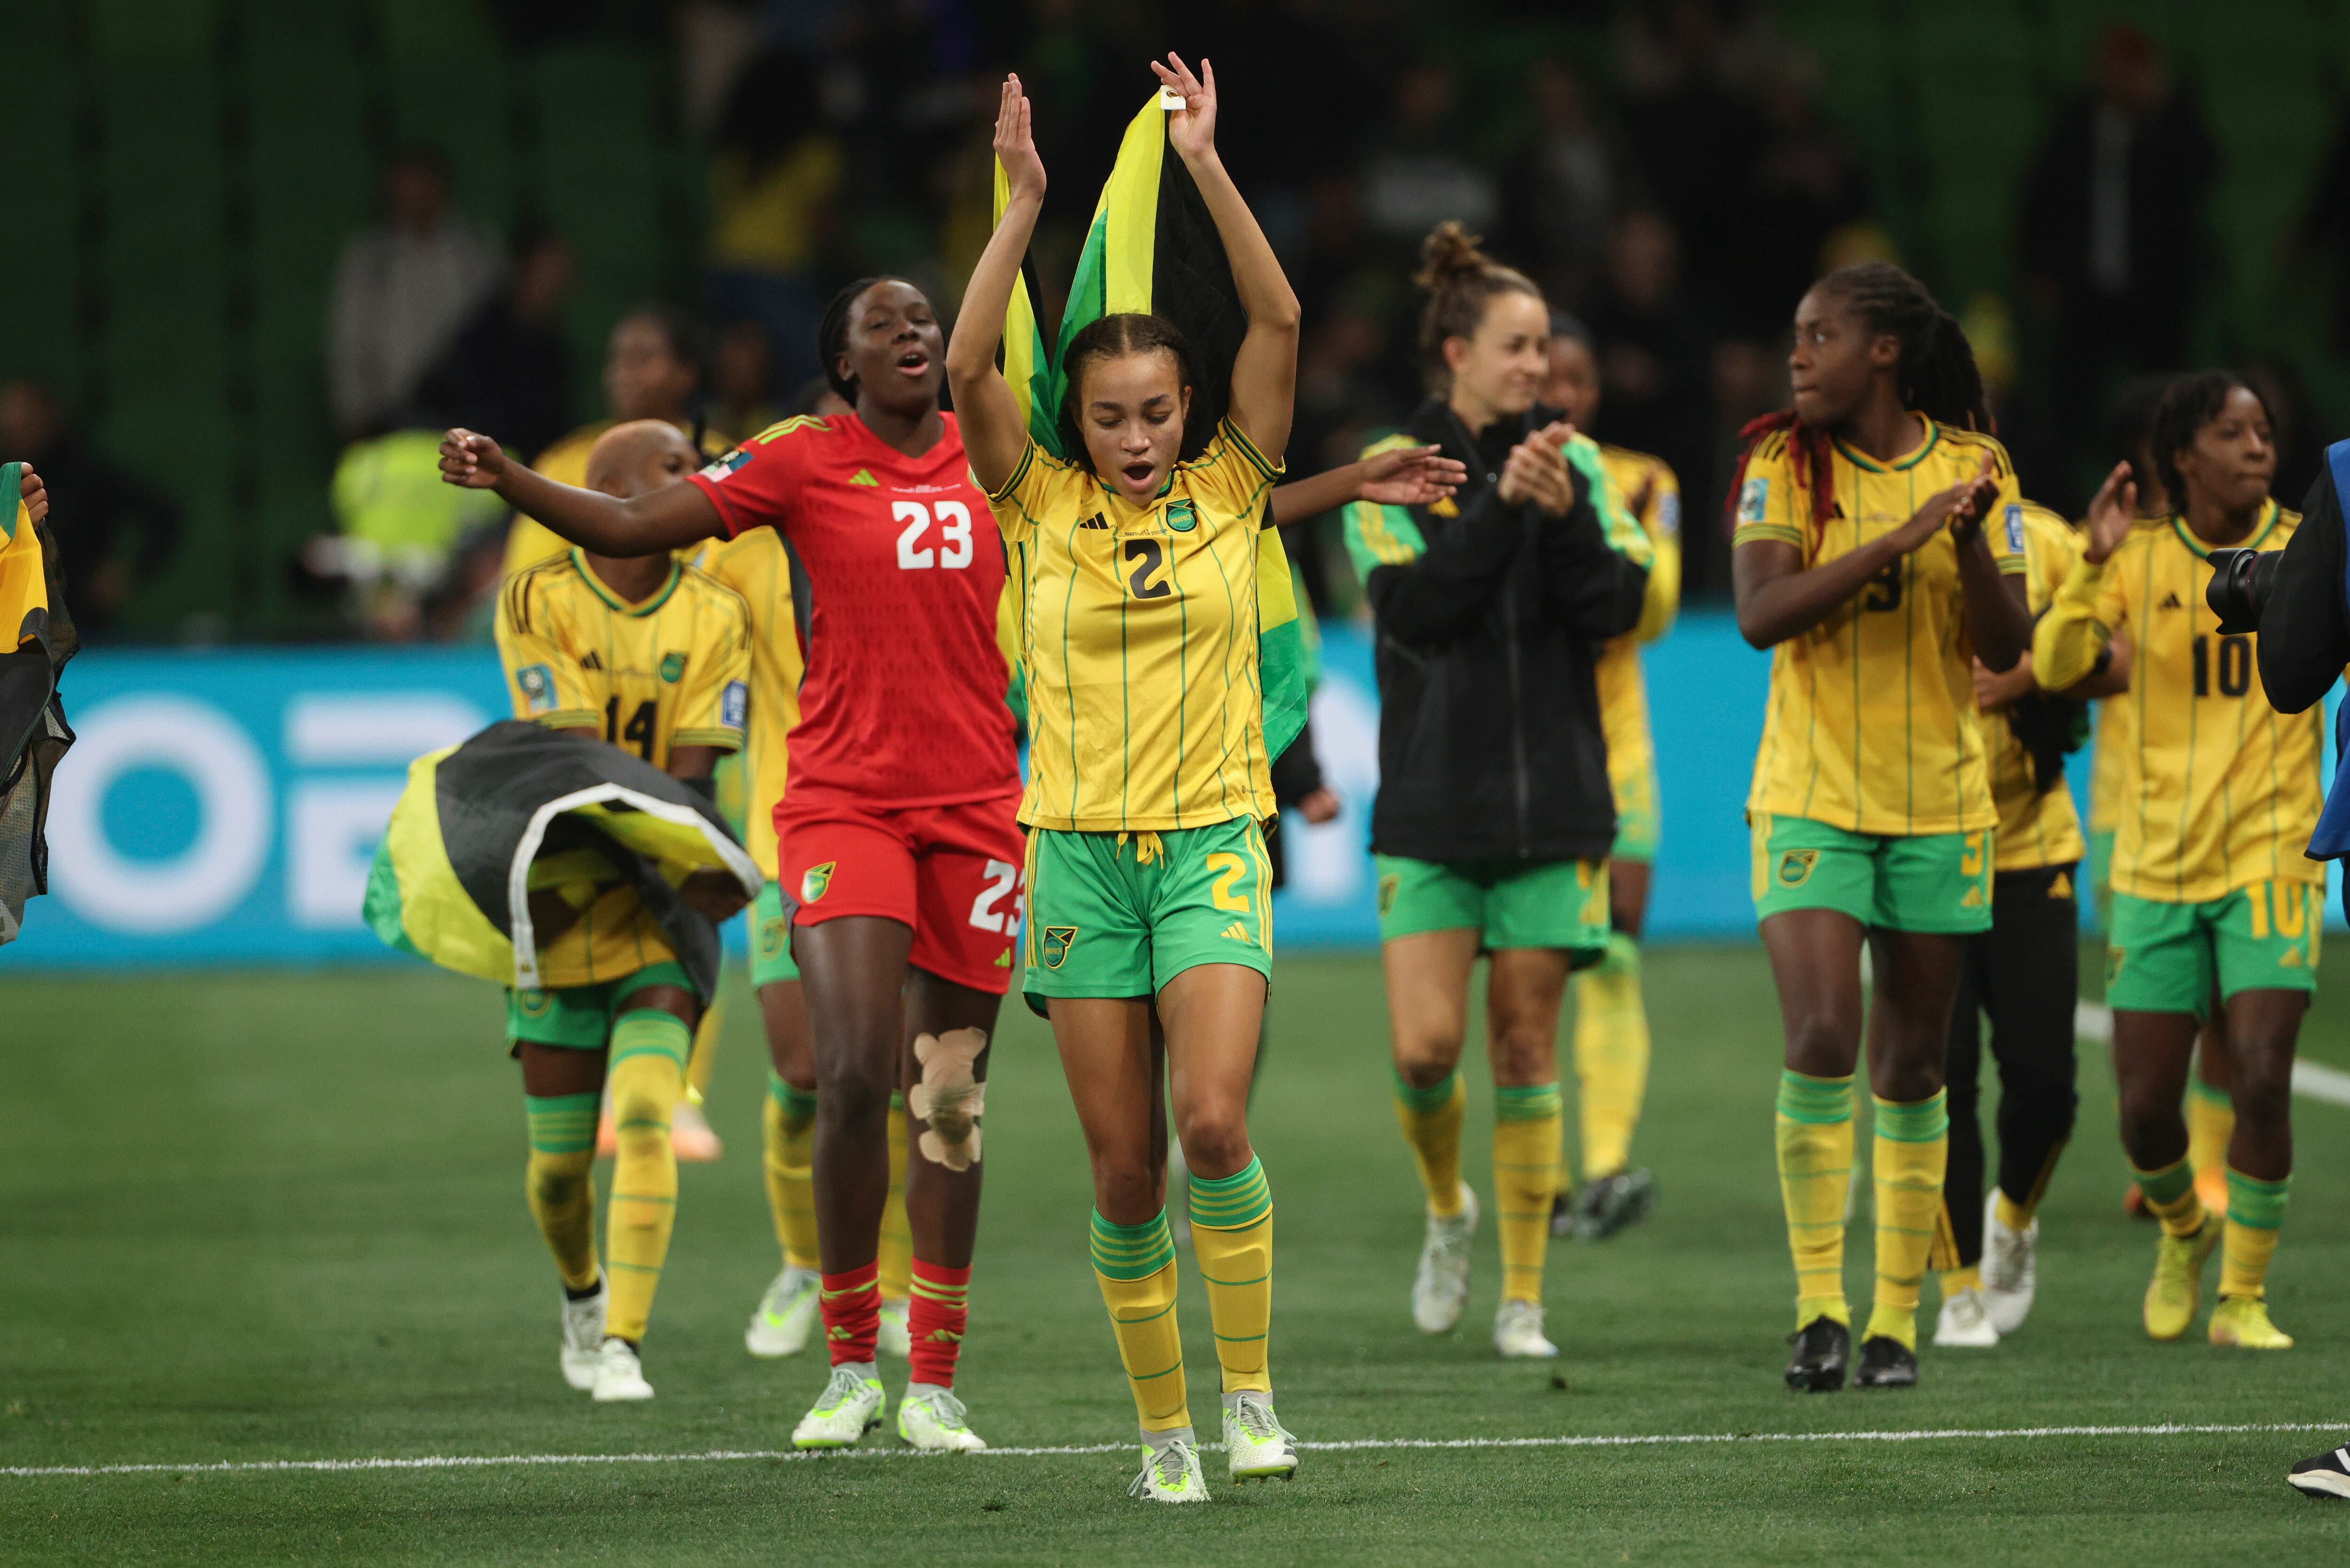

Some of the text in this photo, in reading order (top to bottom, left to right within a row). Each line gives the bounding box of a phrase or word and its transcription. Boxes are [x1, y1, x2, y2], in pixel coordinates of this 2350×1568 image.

[892, 501, 973, 569] 23
[1169, 514, 1194, 525] JAMAICA
[1125, 539, 1171, 598] 2
[2193, 635, 2250, 697] 10
[606, 695, 657, 762] 14
[1206, 853, 1249, 912] 2
[2246, 879, 2304, 938] 10
